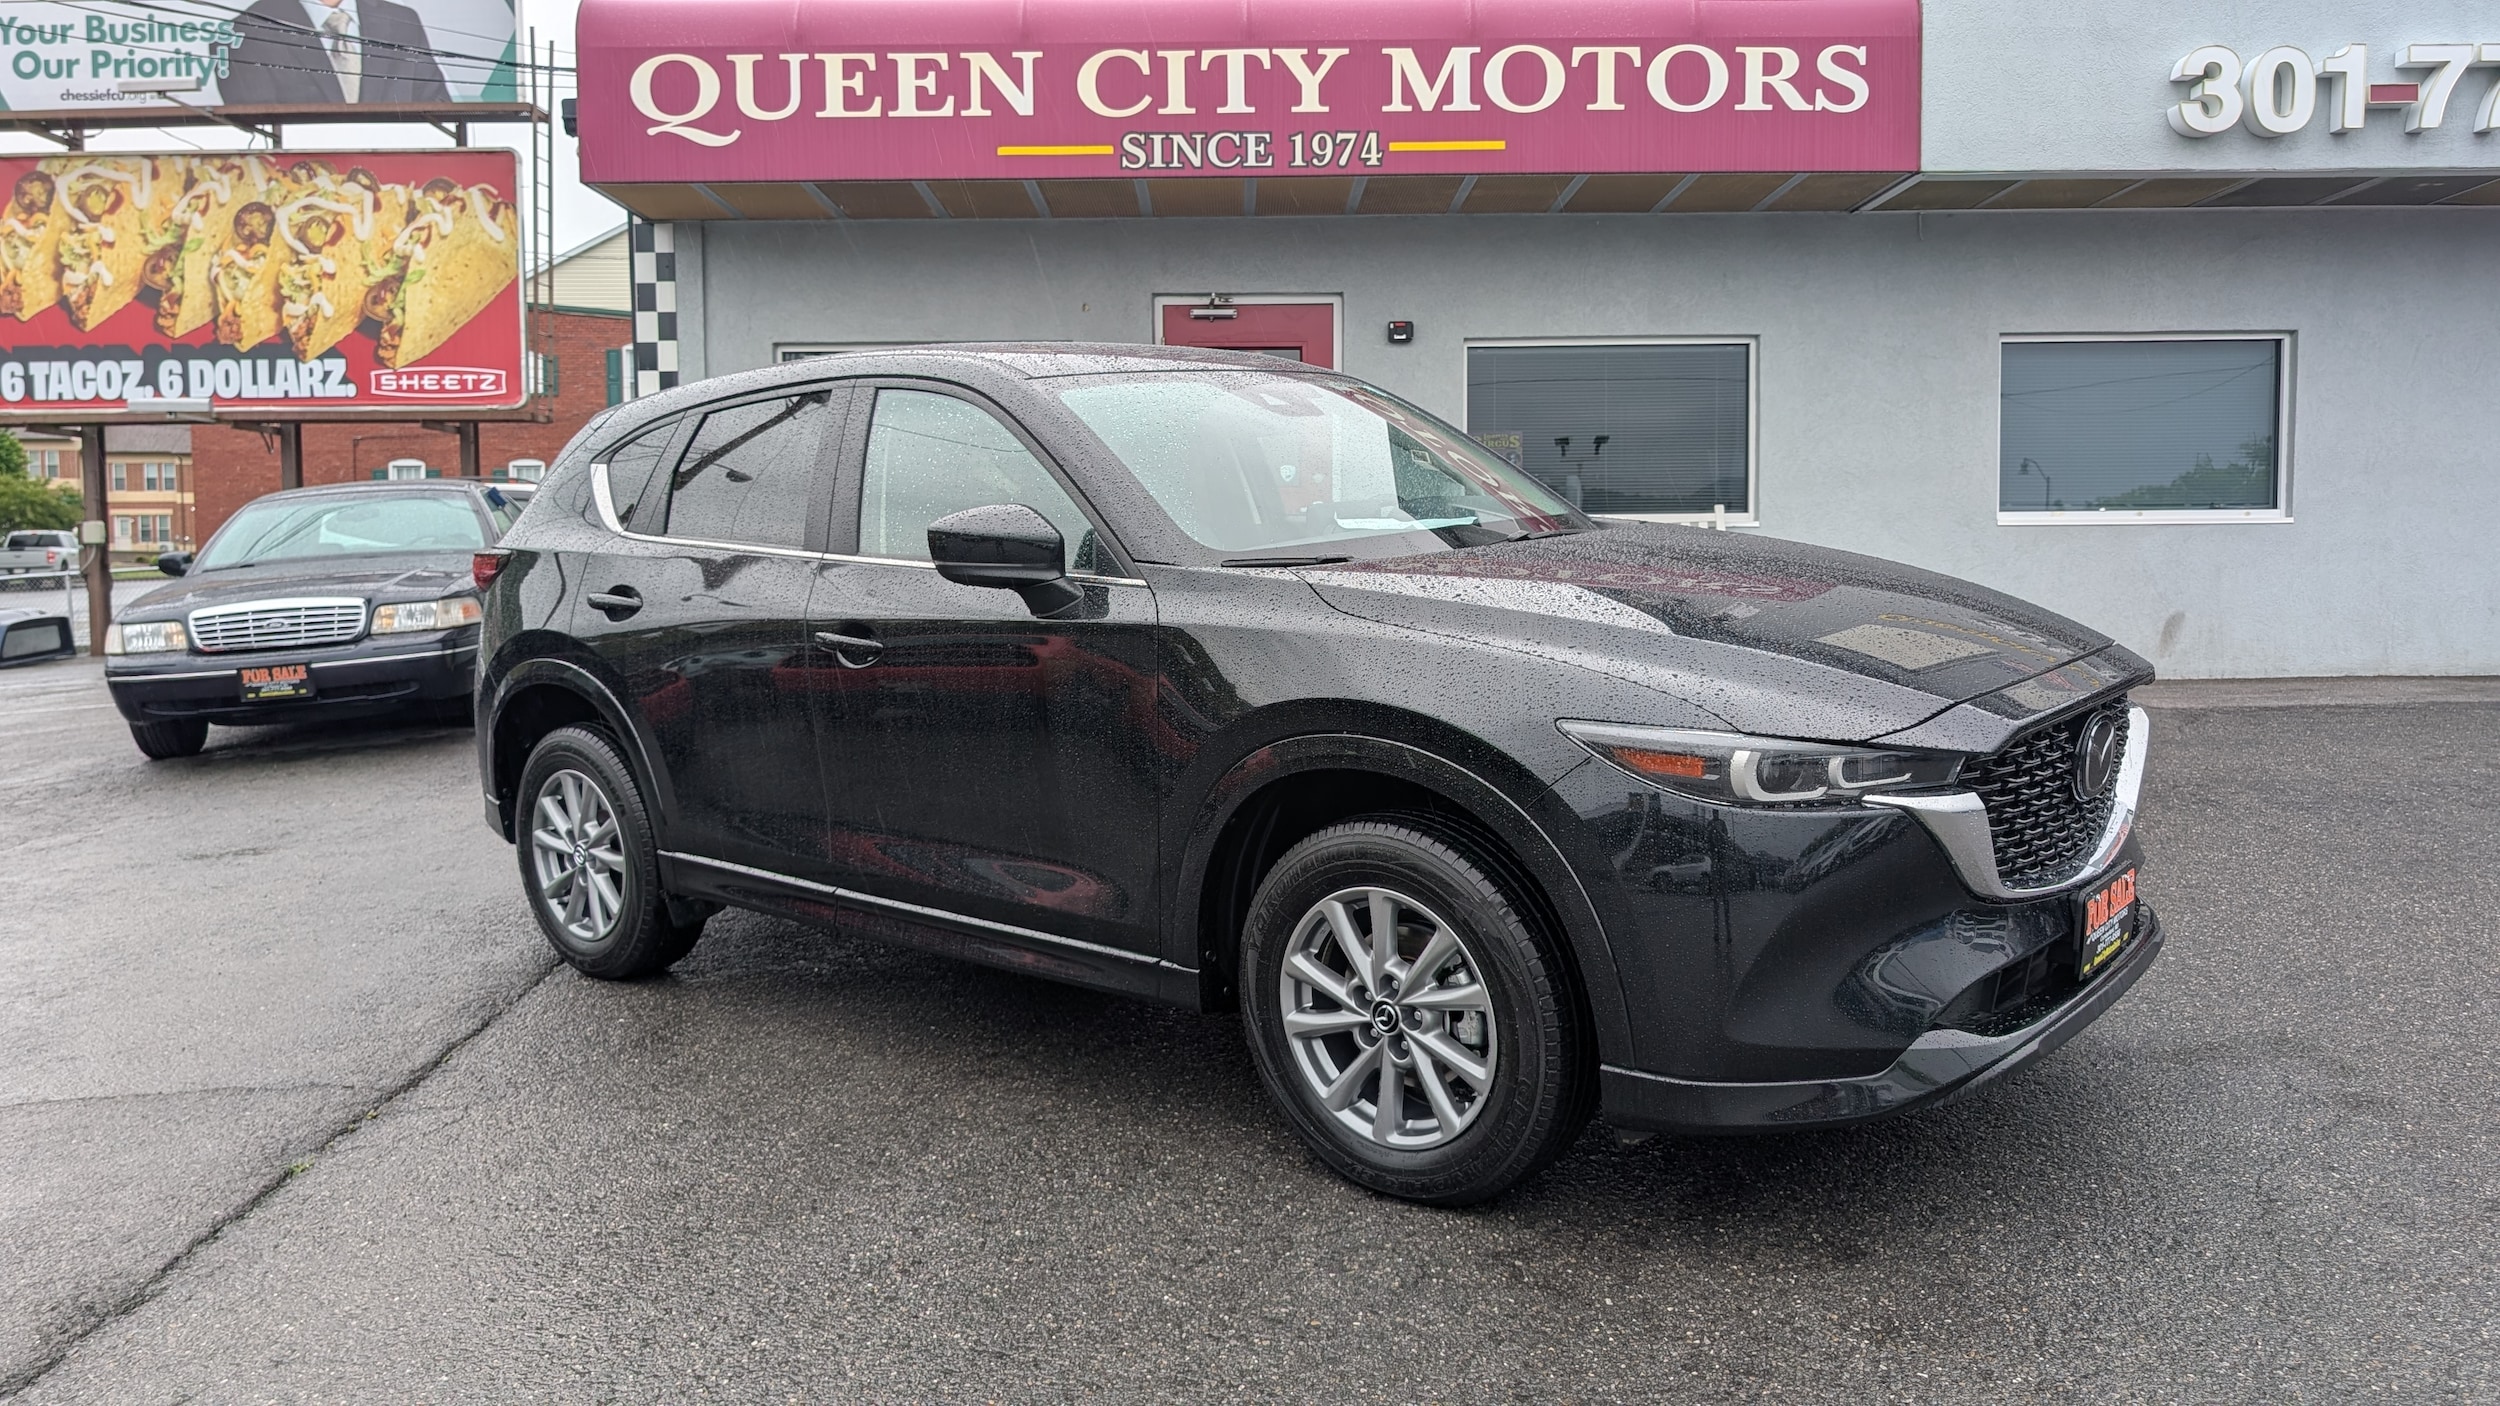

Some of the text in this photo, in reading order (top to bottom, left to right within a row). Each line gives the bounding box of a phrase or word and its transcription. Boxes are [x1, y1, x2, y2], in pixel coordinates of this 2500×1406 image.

[0, 12, 244, 49] Your Business,
[12, 47, 230, 85] Our Priority!
[629, 44, 1870, 147] QUEEN CITY MOTORS
[1120, 130, 1384, 170] SINCE 1974
[2, 357, 358, 401] 6 TACOZ. 6 DOLLARZ.
[380, 373, 497, 392] SHEETZ
[241, 668, 271, 684] FOR
[272, 665, 308, 681] SALE
[2086, 868, 2135, 936] FOR SALE
